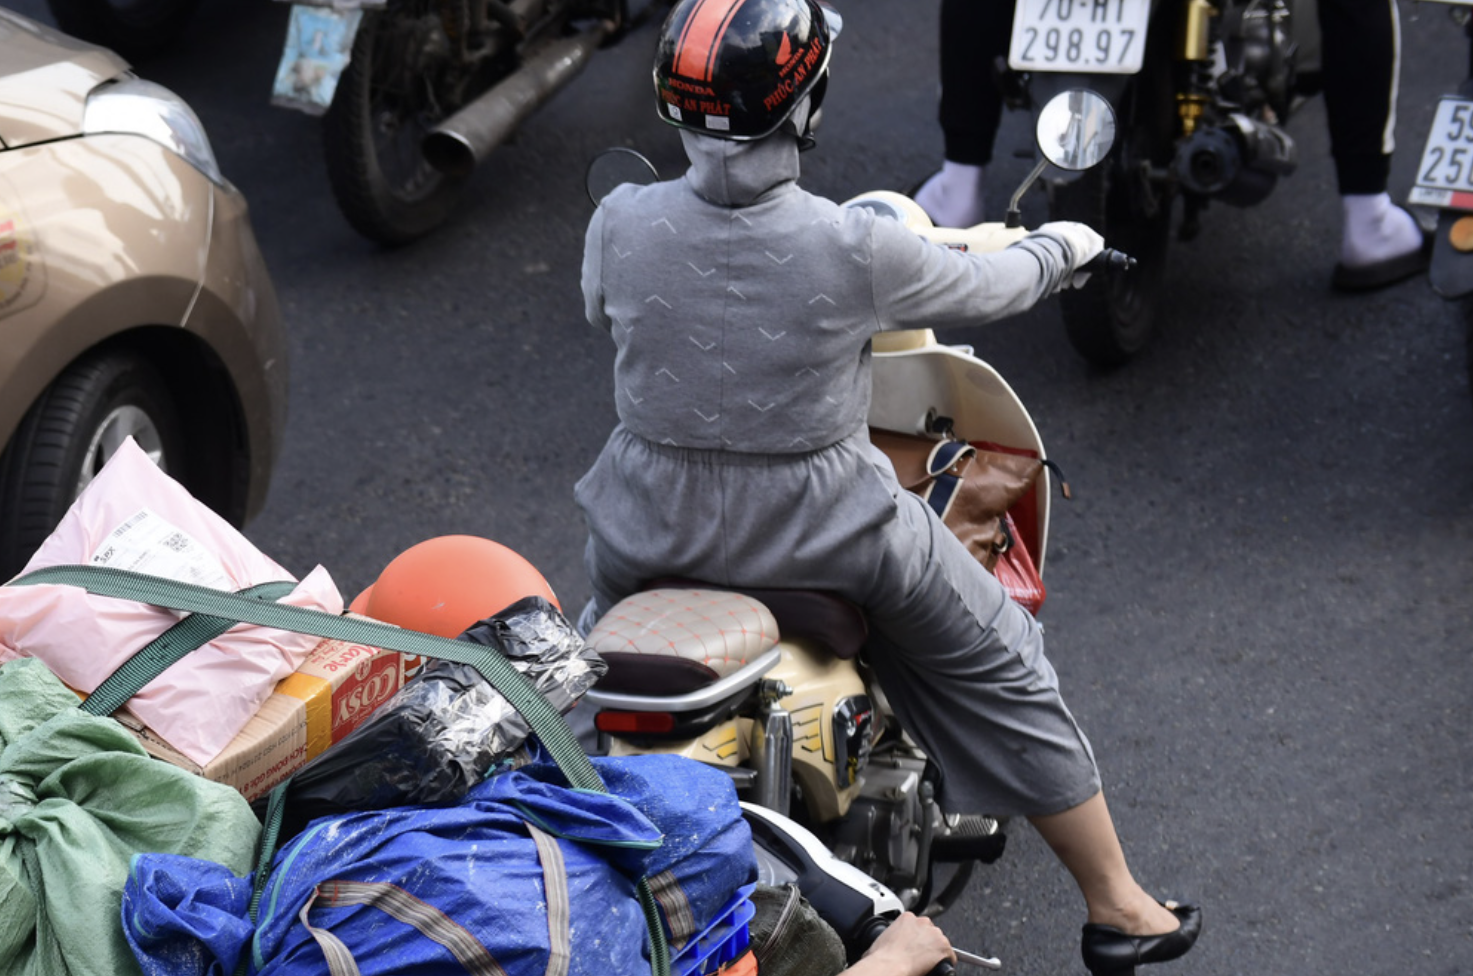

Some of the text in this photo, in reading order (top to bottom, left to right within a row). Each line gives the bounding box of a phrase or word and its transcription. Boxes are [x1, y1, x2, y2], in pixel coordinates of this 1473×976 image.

[1021, 27, 1136, 65] 298.97
[778, 47, 804, 78] HONDA
[668, 77, 715, 97] HONDA
[793, 66, 808, 85] AN
[683, 99, 697, 112] AN
[335, 662, 398, 728] COSY
